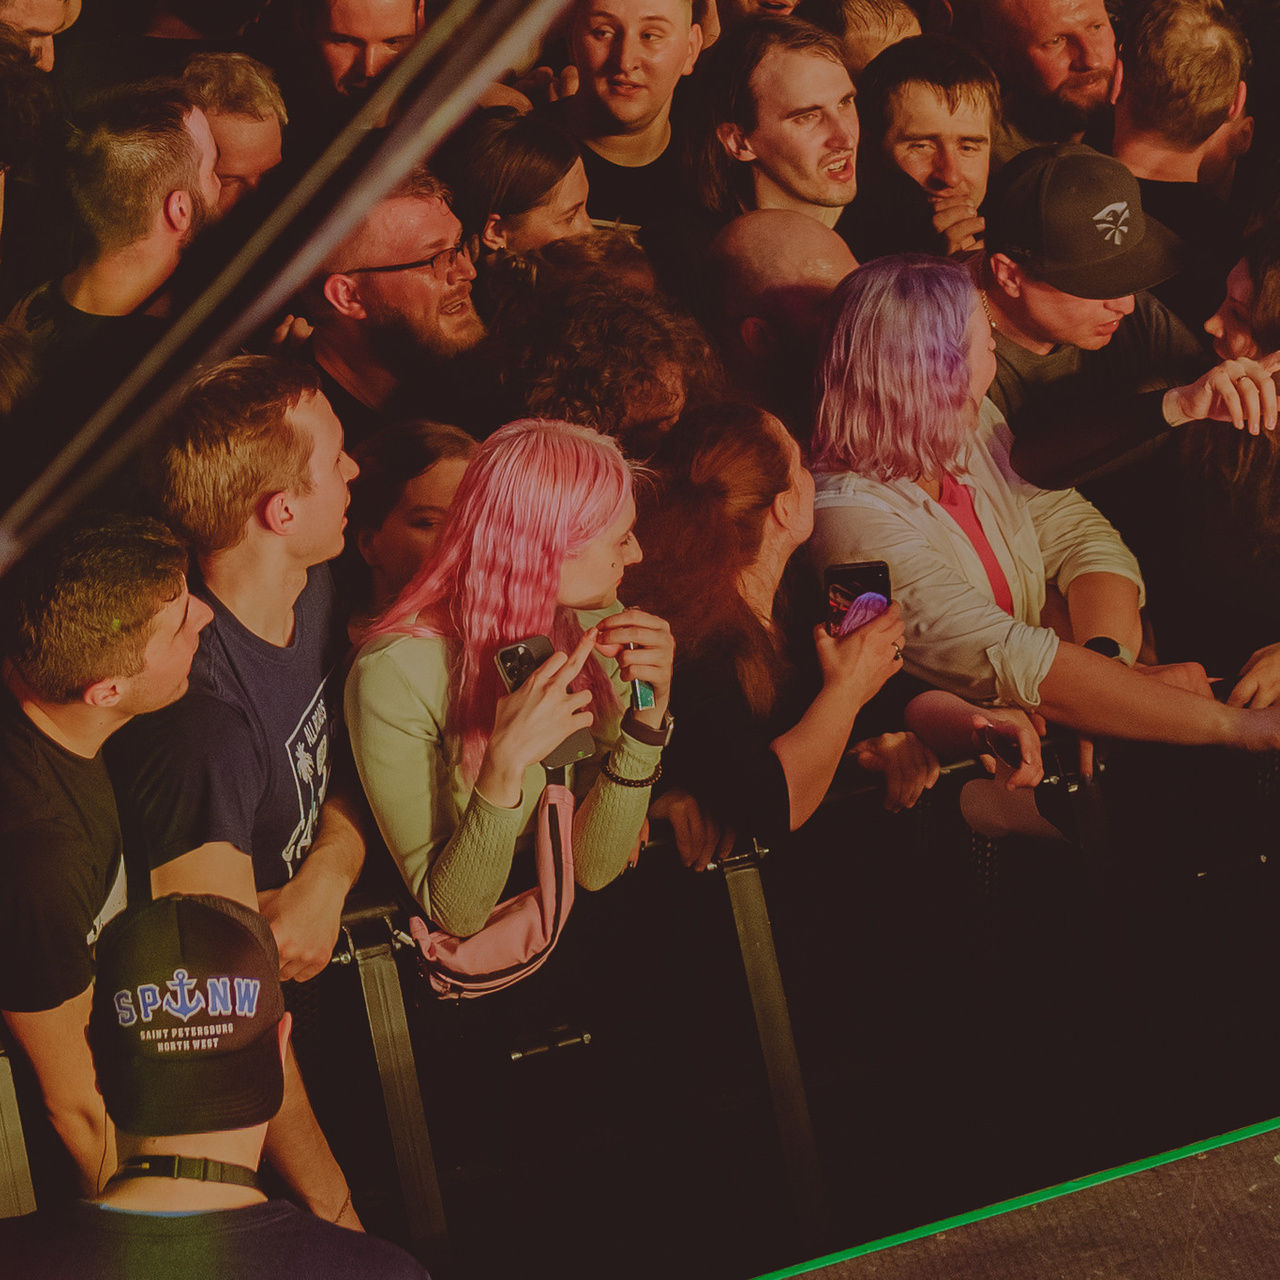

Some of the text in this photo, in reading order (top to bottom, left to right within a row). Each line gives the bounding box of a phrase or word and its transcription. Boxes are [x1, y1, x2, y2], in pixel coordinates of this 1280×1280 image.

[140, 1022, 234, 1041] SAINT PETERSBURG
[157, 1038, 219, 1053] NORTH WEST
